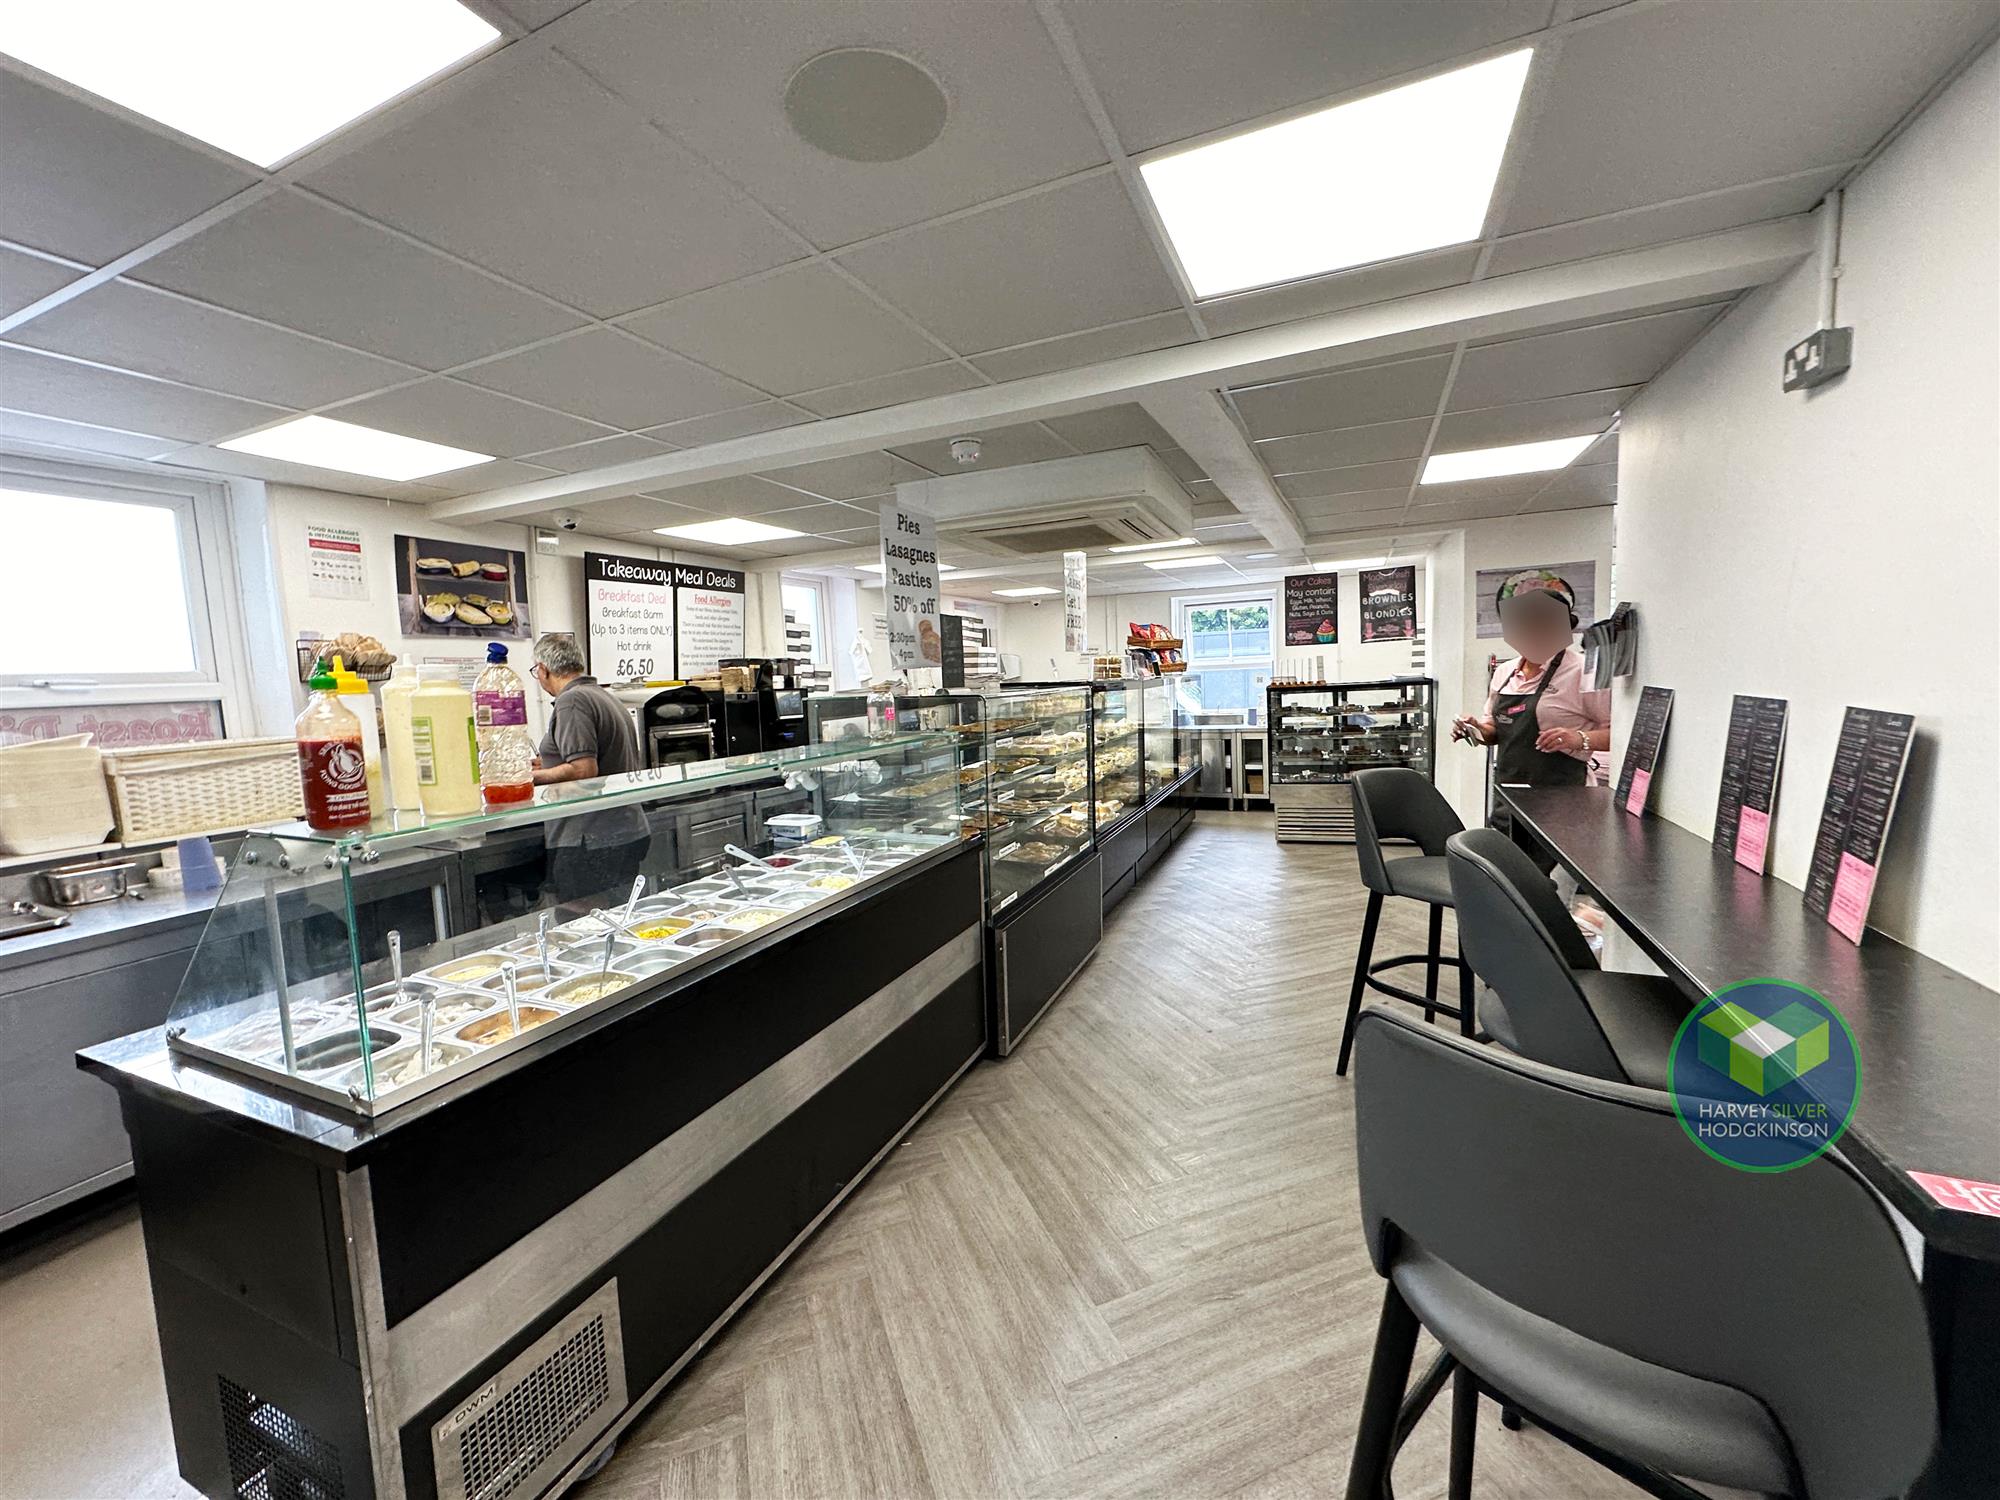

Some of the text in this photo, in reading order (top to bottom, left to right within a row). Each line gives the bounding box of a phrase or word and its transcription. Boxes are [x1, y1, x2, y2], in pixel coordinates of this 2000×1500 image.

[896, 513, 921, 535] Pies
[884, 537, 936, 566] Lasagnes
[598, 558, 736, 588] Takeaway Meal Deals
[891, 567, 932, 590] Pasties
[1290, 577, 1332, 587] Our Cakes
[598, 588, 667, 605] Breakfast Deal
[694, 594, 707, 605] Food
[1286, 589, 1304, 599] May
[1362, 592, 1414, 606] BROWNIES
[602, 607, 664, 619] Breakfast Barm
[893, 595, 936, 615] 50% off
[1363, 607, 1413, 620] BLONDIES
[591, 623, 606, 637] (Up
[608, 625, 617, 635] to
[619, 624, 625, 634] 3
[627, 625, 648, 636] items
[650, 625, 673, 637] ONLY)
[616, 641, 652, 651] Hot drink
[889, 632, 916, 648] 2:30pm
[616, 658, 654, 676] £6.50
[456, 1387, 493, 1422] DWM
